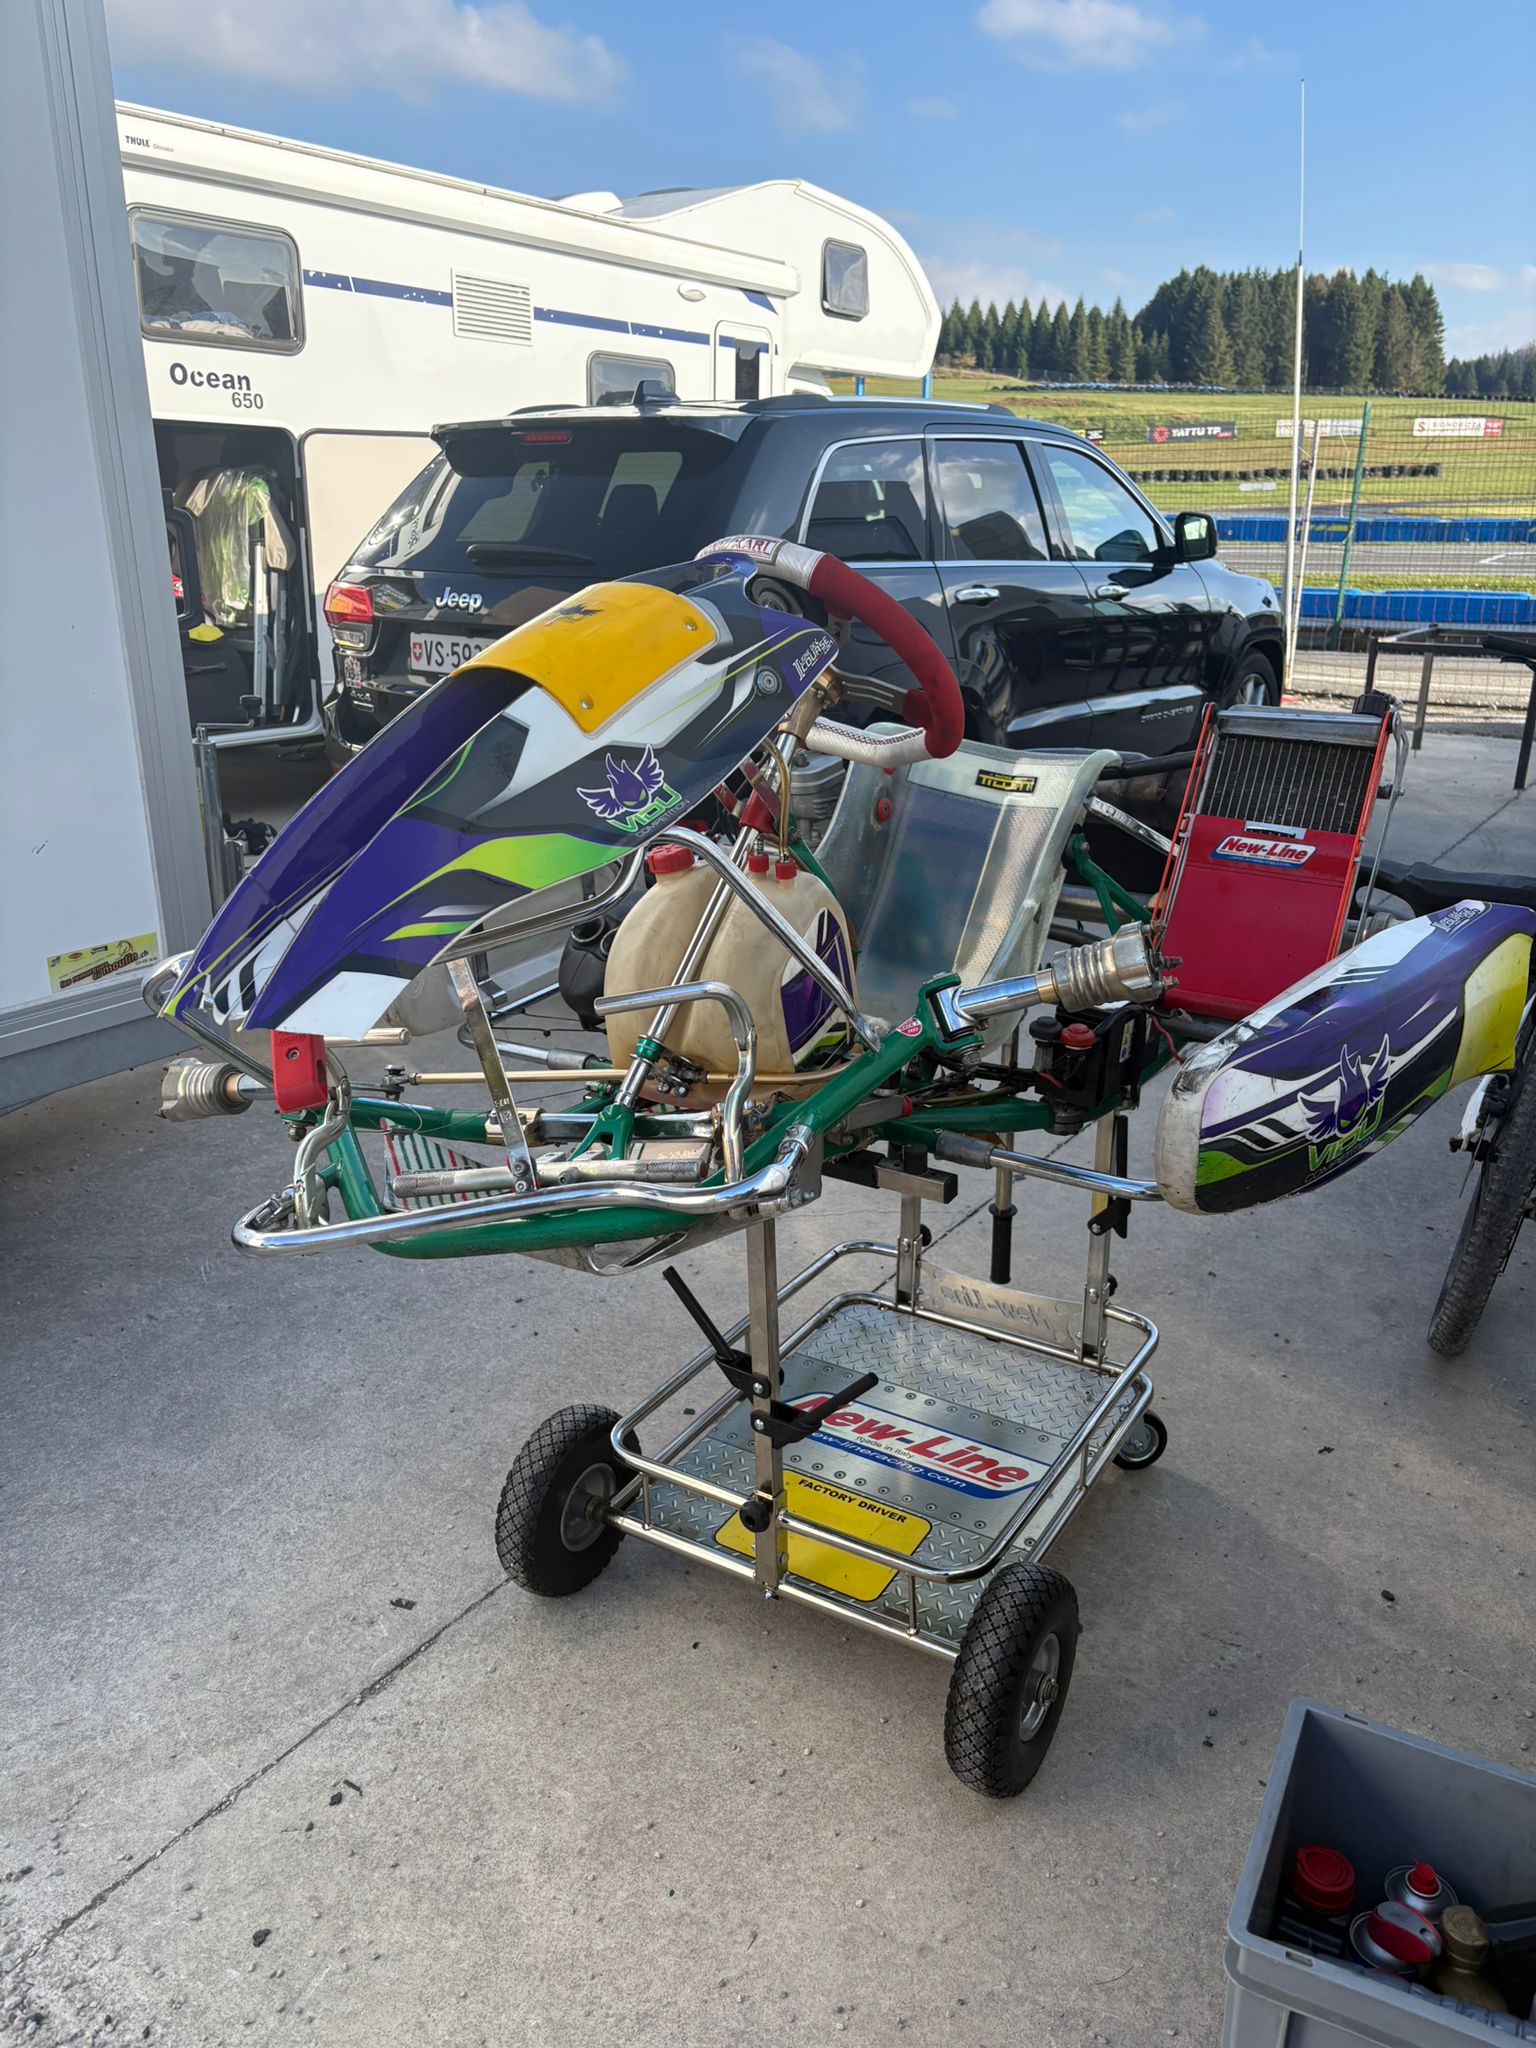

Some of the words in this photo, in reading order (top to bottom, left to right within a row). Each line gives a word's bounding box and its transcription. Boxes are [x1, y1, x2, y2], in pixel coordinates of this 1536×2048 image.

[125, 135, 151, 148] THULE
[169, 362, 251, 392] Ocean
[231, 391, 264, 411] 650
[435, 586, 483, 614] Jeep
[635, 798, 691, 838] COMPETITION
[1220, 838, 1308, 860] New-Line
[811, 1431, 966, 1488] ew-lineracing.com
[856, 1436, 882, 1449] made
[883, 1442, 893, 1451] in
[894, 1445, 915, 1459] italy
[798, 1479, 857, 1504] FACTORY
[857, 1501, 908, 1523] DRIVER
